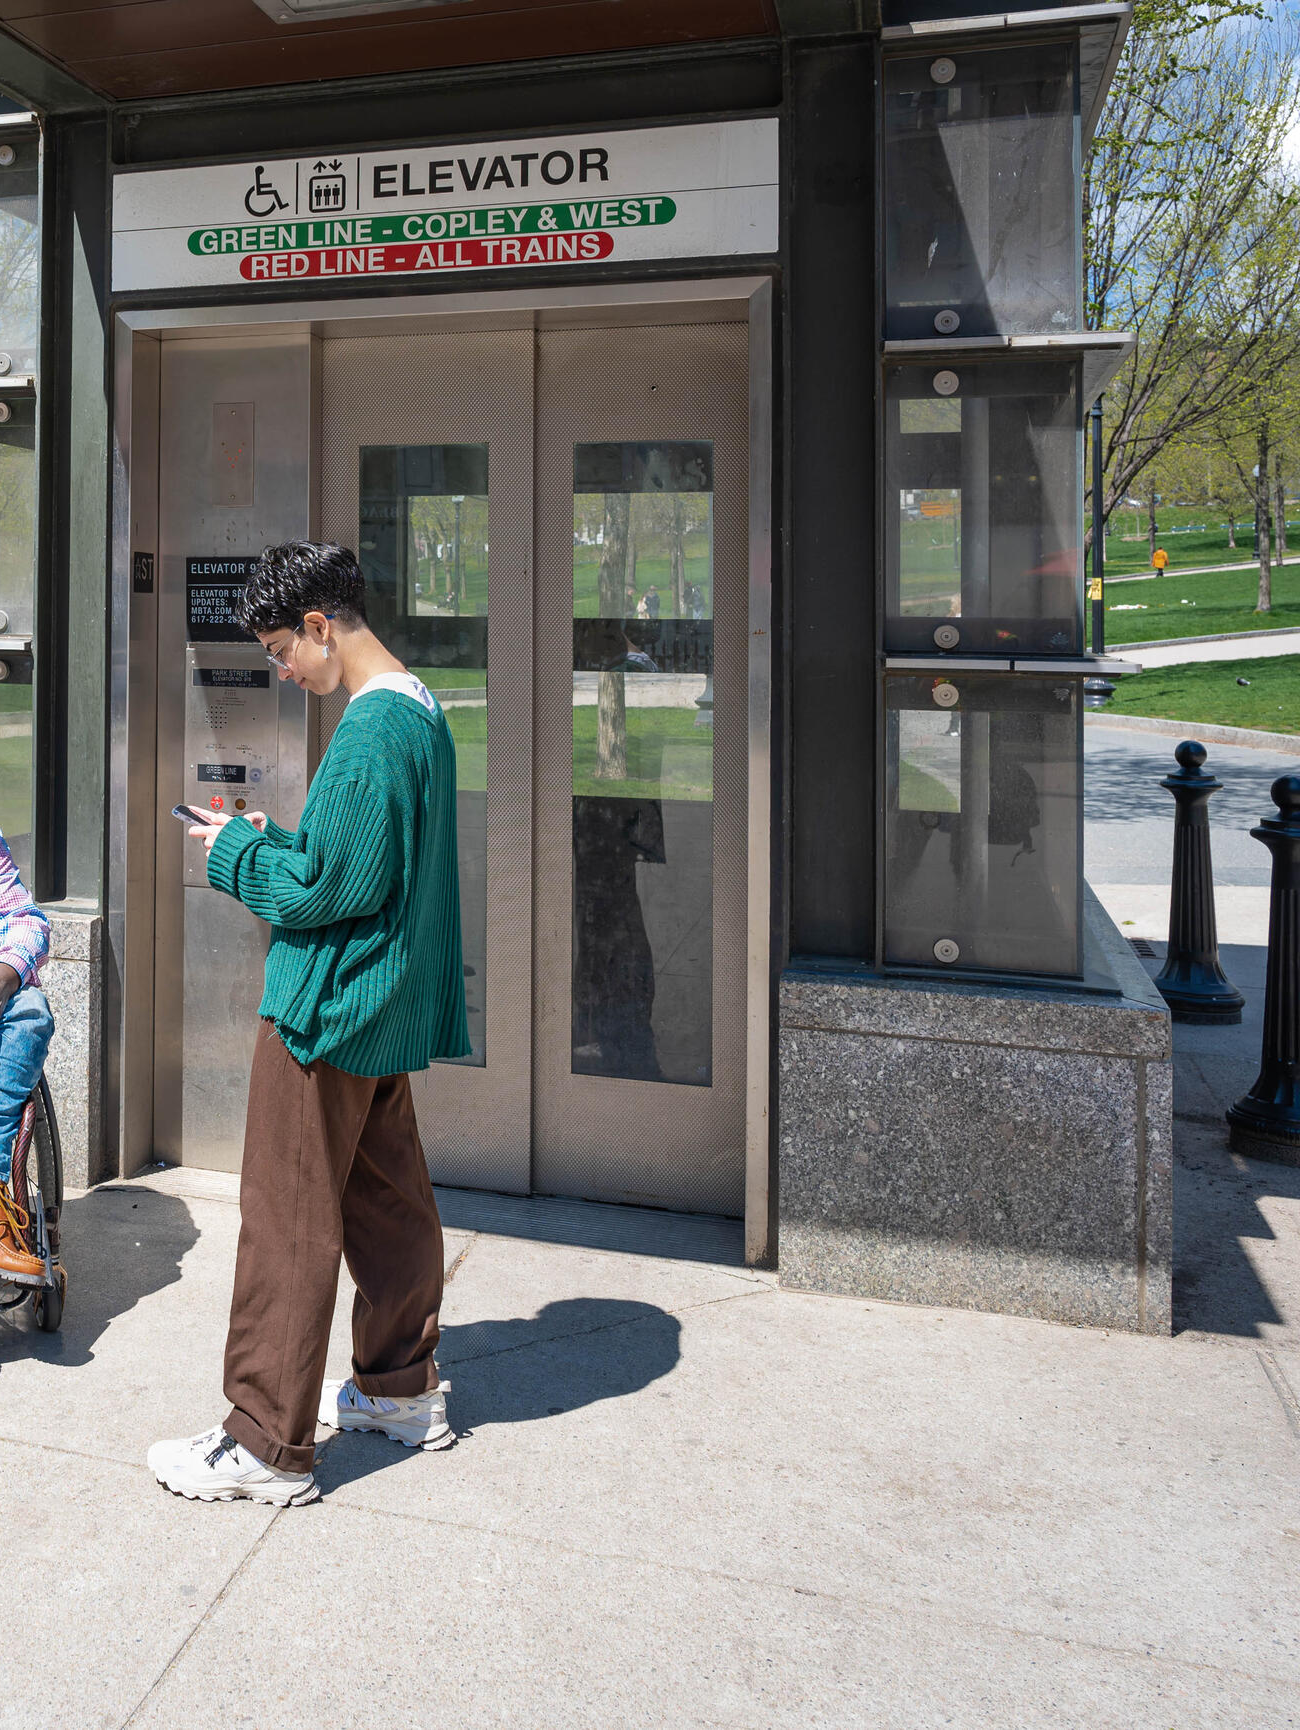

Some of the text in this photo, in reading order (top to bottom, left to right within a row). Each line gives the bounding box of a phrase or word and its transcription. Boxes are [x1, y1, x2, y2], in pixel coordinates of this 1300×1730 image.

[373, 147, 609, 198] ELEVATOR
[199, 225, 297, 255] GREEN
[307, 219, 373, 247] LINE
[402, 208, 529, 240] COPLEY
[537, 206, 559, 231] &
[568, 198, 663, 228] WEST
[251, 253, 310, 279] RED
[320, 248, 386, 275] LINE
[414, 242, 470, 269] ALL
[481, 233, 601, 265] TRAINS
[191, 563, 245, 574] ELEVATOR
[191, 589, 229, 598] ELEVATOR
[191, 598, 228, 606] UPDATES:
[191, 607, 232, 615] MBTA.COM
[212, 669, 252, 678] PARK STREET
[206, 765, 237, 776] GREEN LINE
